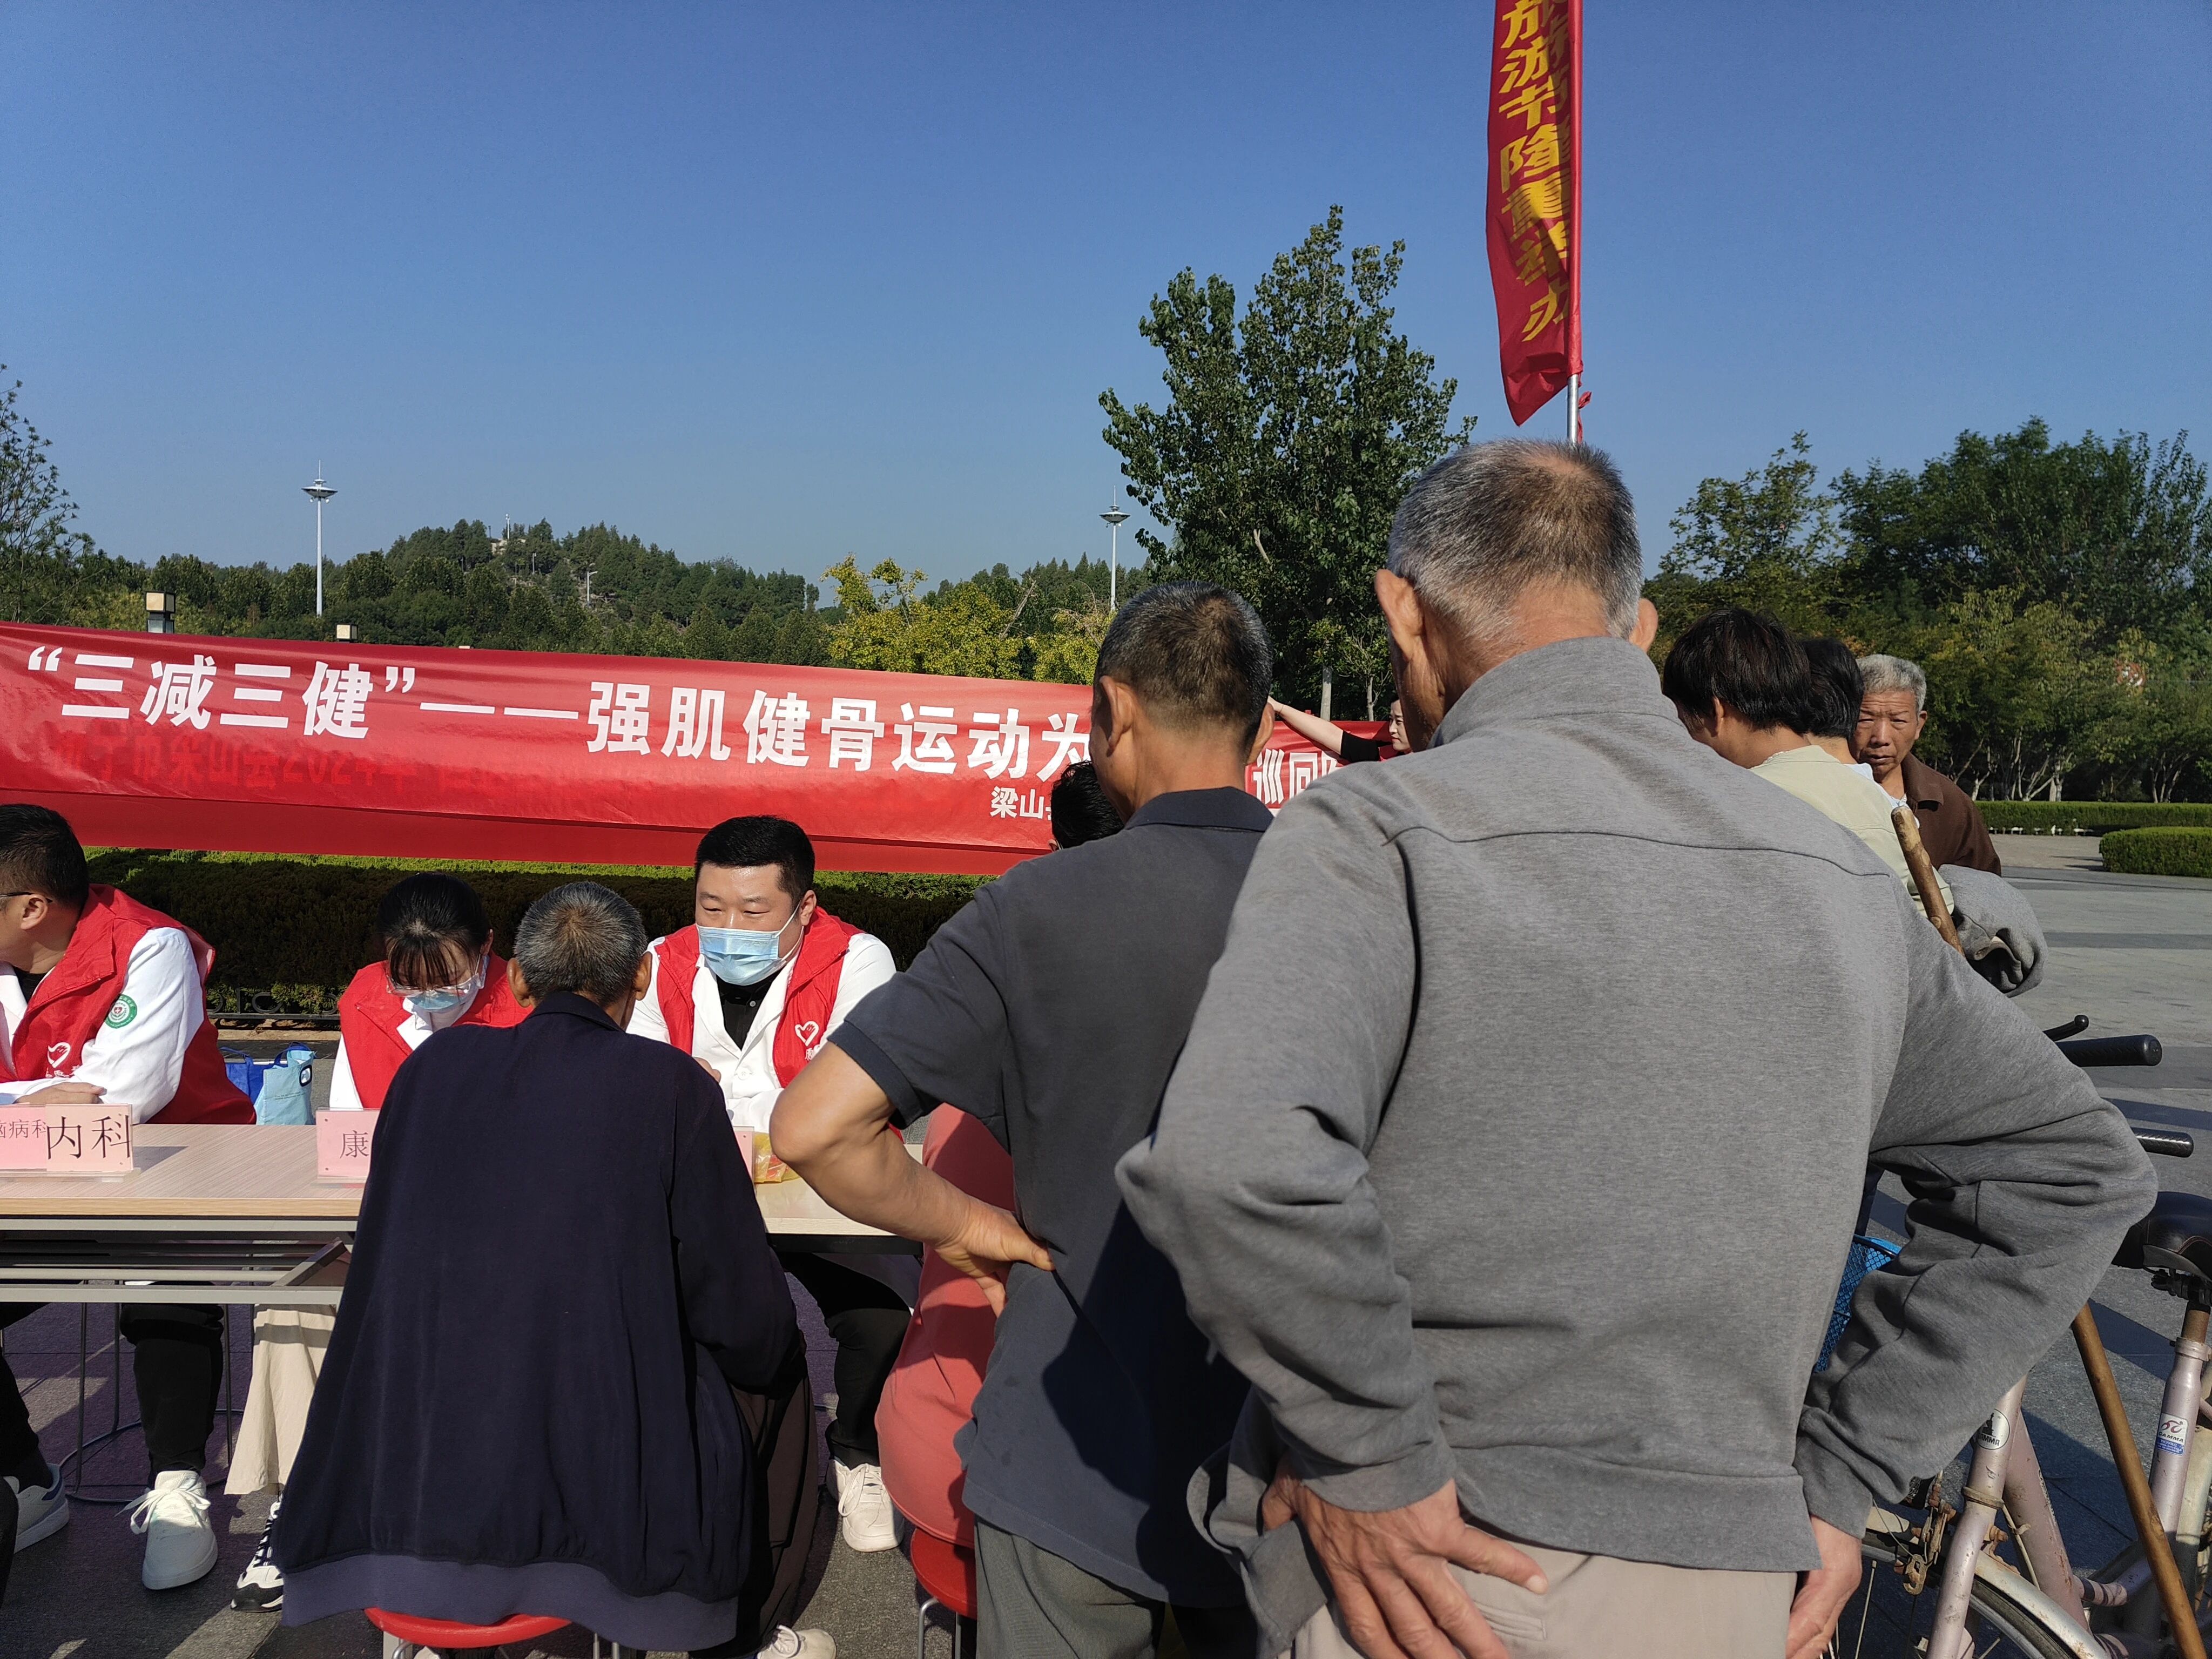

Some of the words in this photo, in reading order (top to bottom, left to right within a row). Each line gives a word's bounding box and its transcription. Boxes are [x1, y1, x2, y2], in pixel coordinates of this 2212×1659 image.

[1252, 748, 1339, 805] 巡回
[989, 786, 1051, 820] 梁山
[46, 1115, 130, 1159] 内科
[339, 1130, 369, 1159] 康
[2159, 1432, 2183, 1442] GAMMA
